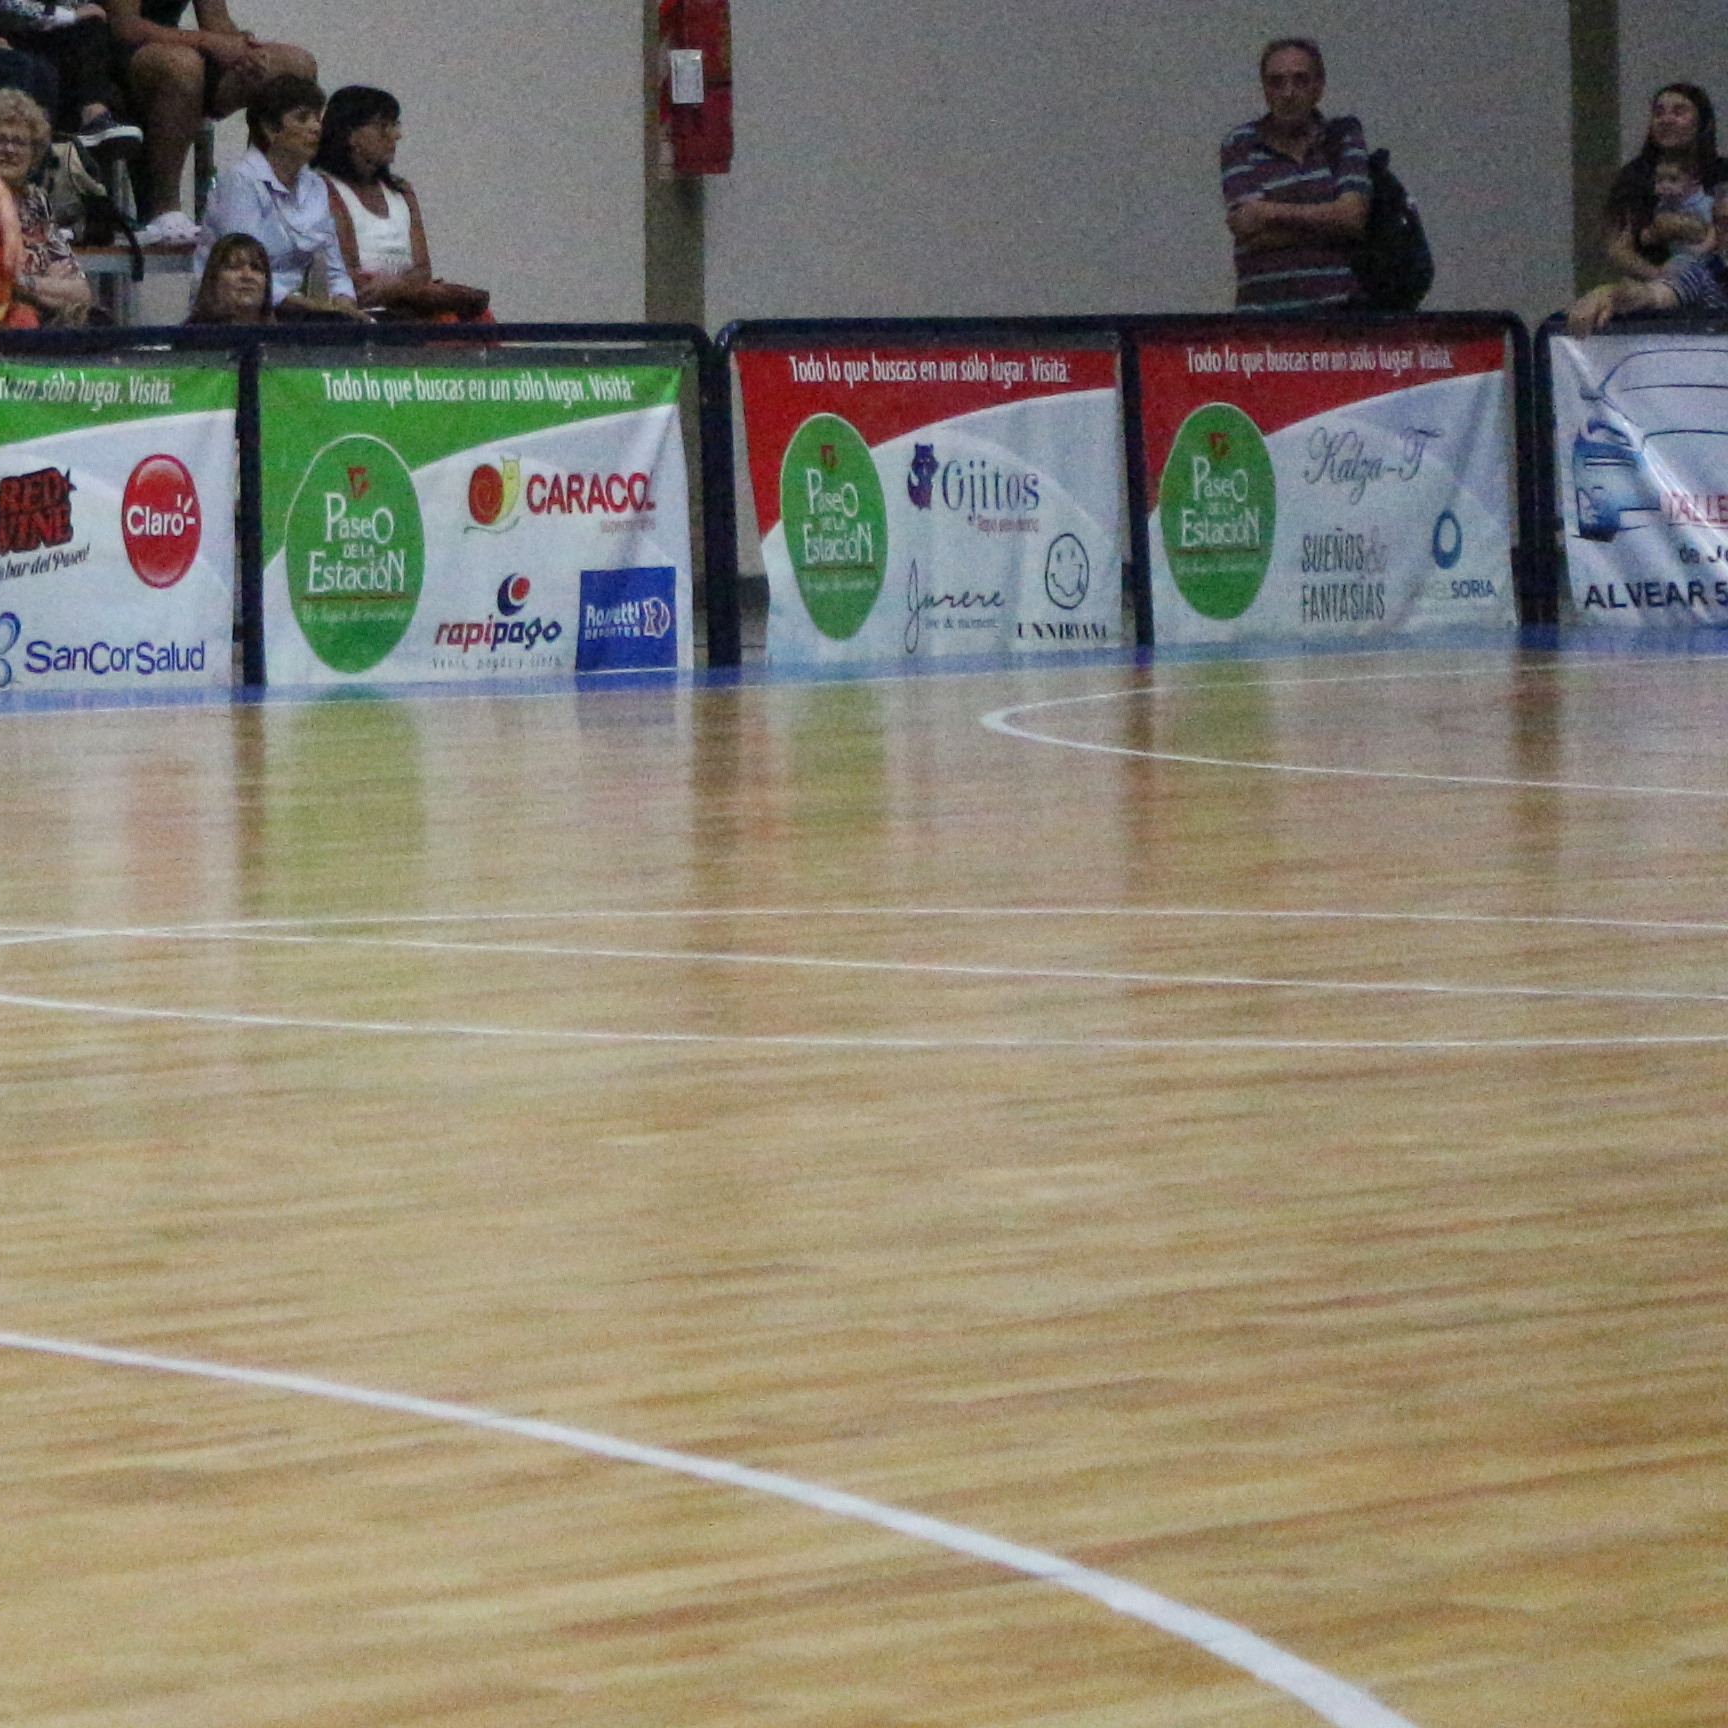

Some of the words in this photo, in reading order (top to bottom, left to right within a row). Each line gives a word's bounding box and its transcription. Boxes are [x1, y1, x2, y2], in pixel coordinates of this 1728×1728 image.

[789, 354, 824, 382] Todo
[827, 352, 840, 381] lo
[844, 360, 869, 388] que
[872, 352, 916, 382] buscas
[920, 361, 936, 381] en
[941, 361, 957, 380] un
[13, 379, 36, 401] un
[322, 371, 361, 400] Todo
[364, 371, 380, 400] lo
[383, 379, 411, 408] que
[414, 371, 464, 400] buscas
[469, 379, 486, 400] en
[491, 379, 510, 400] un
[127, 506, 185, 536] Claro
[1451, 579, 1496, 600] SORIA
[1584, 581, 1708, 609] ALVEAR
[435, 615, 562, 653] rapipago
